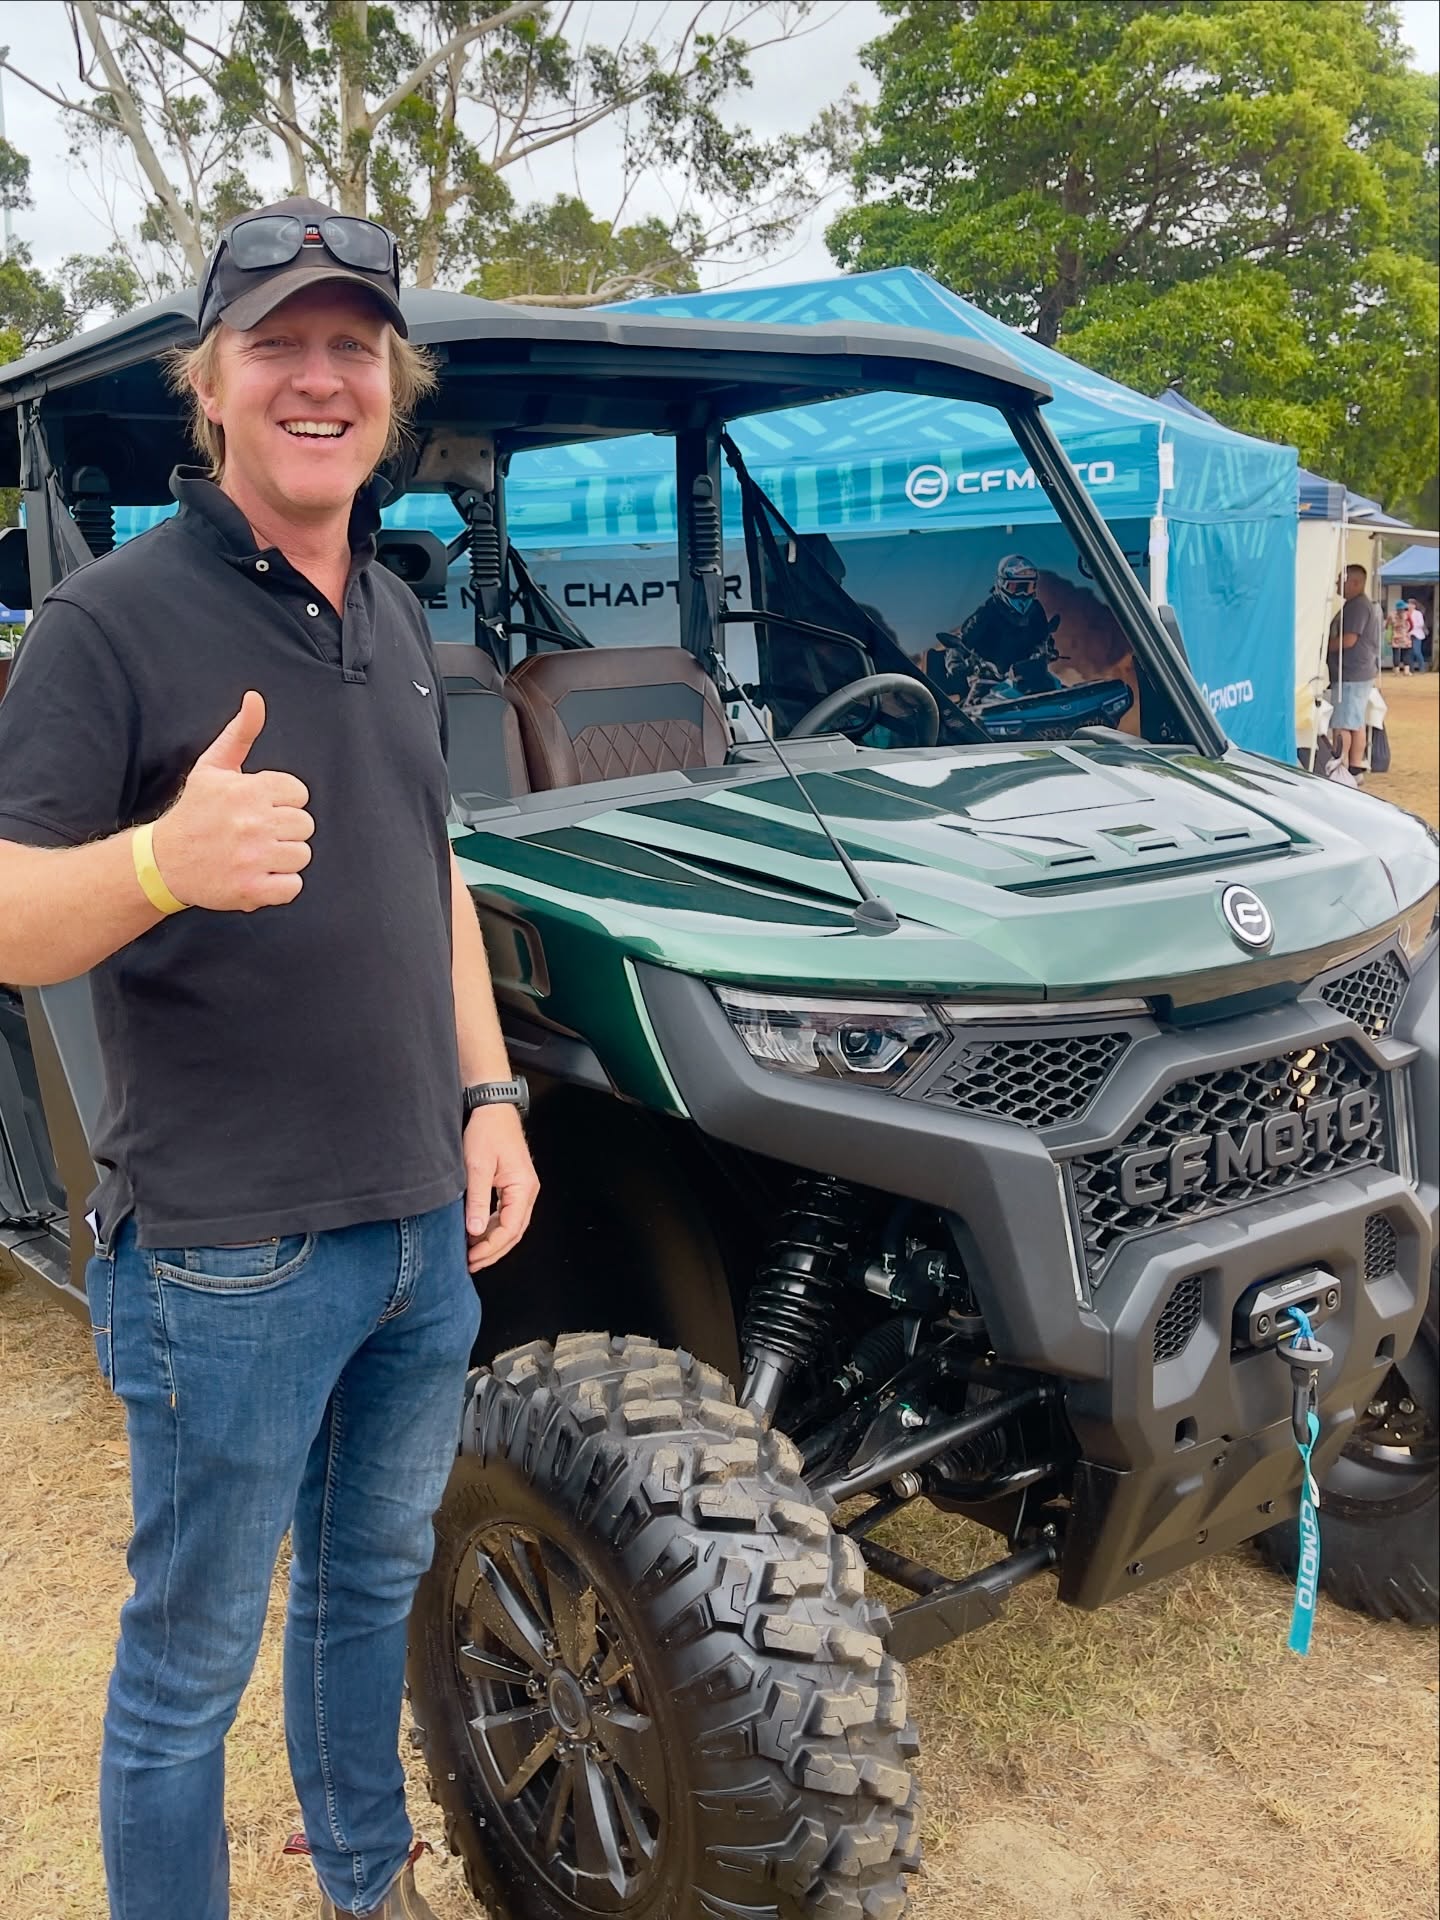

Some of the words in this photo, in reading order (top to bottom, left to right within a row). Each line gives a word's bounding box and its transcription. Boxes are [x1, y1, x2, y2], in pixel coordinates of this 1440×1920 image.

[956, 461, 1115, 494] CFMTO
[564, 575, 742, 607] CHAPTR
[1120, 1088, 1371, 1206] CFMOTO
[1298, 1499, 1318, 1610] CFMOTO
